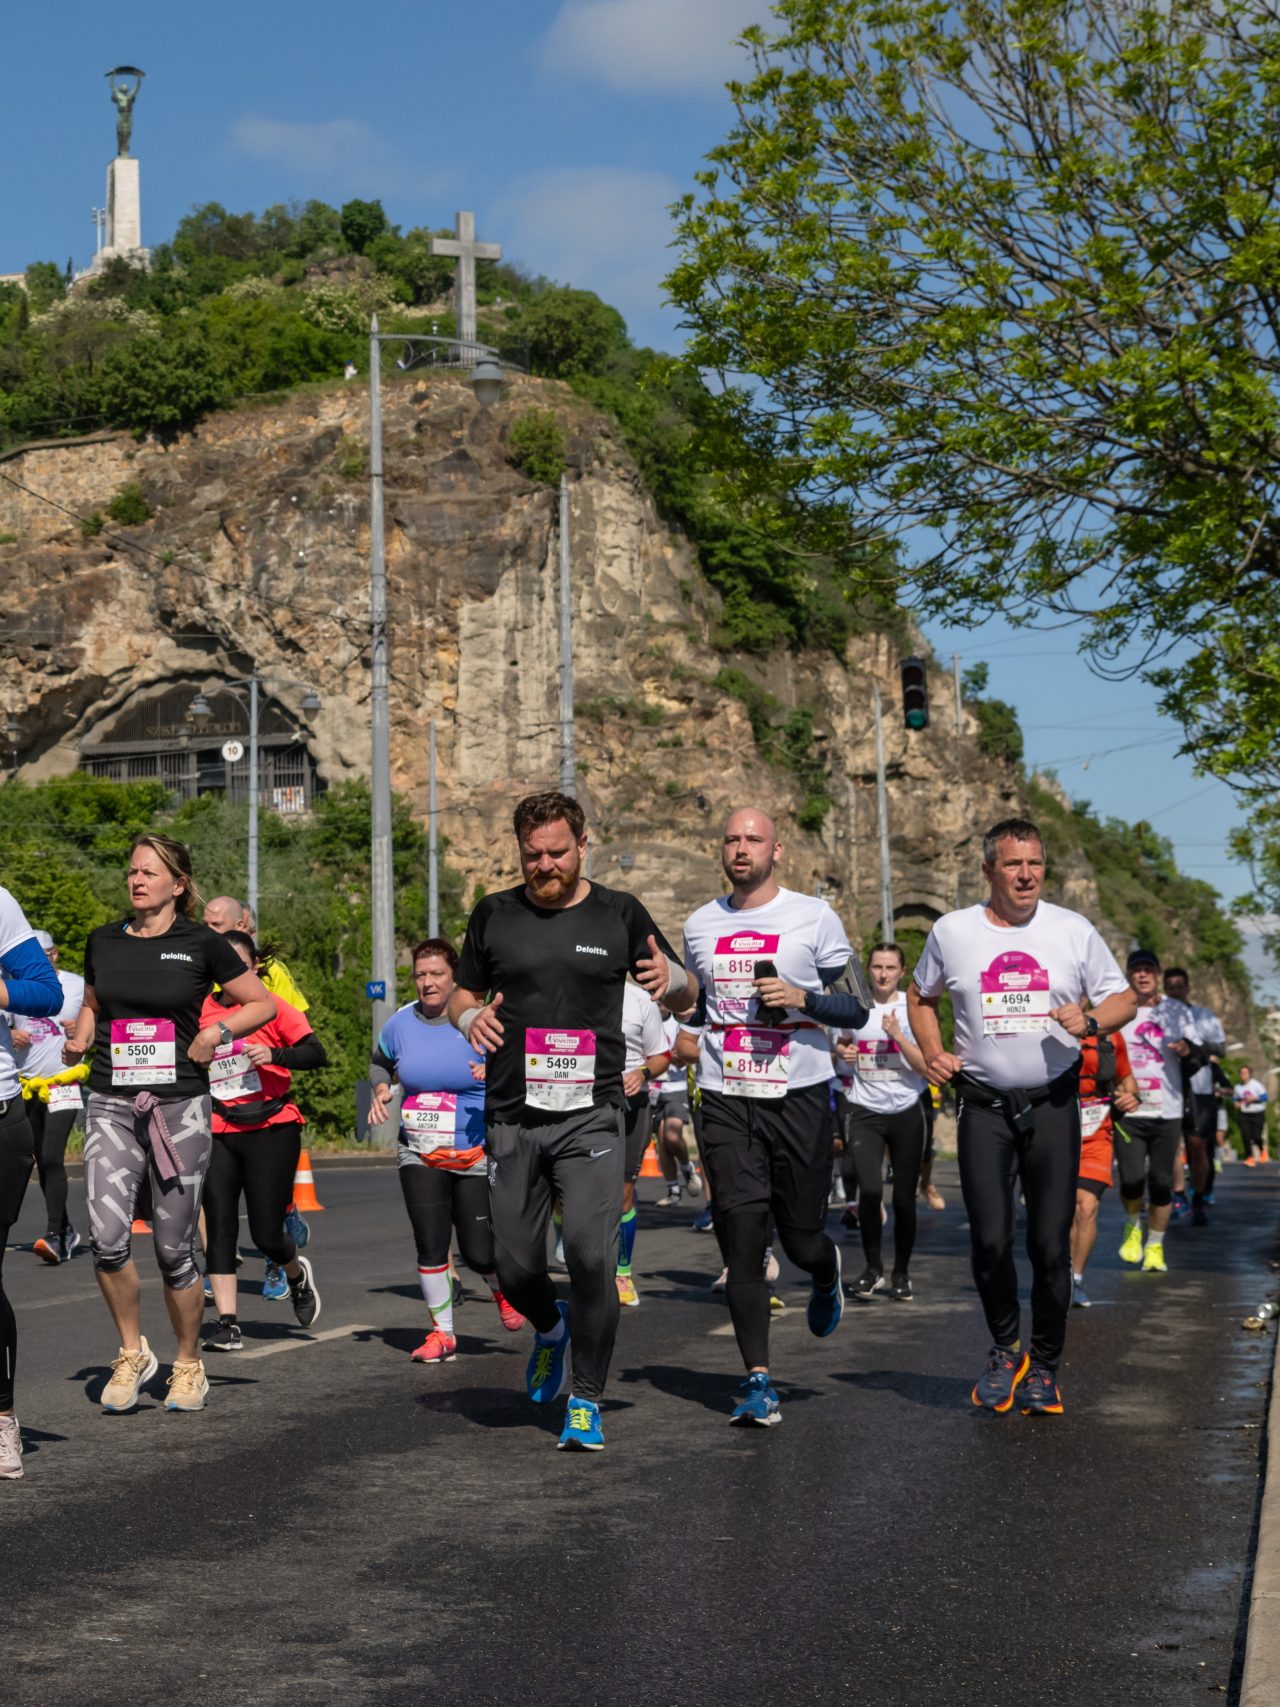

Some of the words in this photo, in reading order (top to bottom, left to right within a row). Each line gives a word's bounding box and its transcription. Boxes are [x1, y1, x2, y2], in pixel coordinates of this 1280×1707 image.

[228, 746, 238, 755] 10
[576, 944, 609, 956] Deloitte.
[160, 952, 193, 962] Deloitte.
[728, 959, 756, 973] 815
[986, 996, 993, 1004] 4
[1001, 994, 1030, 1005] 4694
[1006, 1005, 1026, 1013] HONZA
[114, 1047, 120, 1055] 5
[128, 1045, 156, 1056] 5500
[218, 1058, 237, 1070] 1914
[530, 1058, 537, 1066] 5
[546, 1057, 578, 1069] 5499
[738, 1059, 769, 1074] 8151
[554, 1071, 569, 1079] DANI
[417, 1112, 439, 1122] 2239
